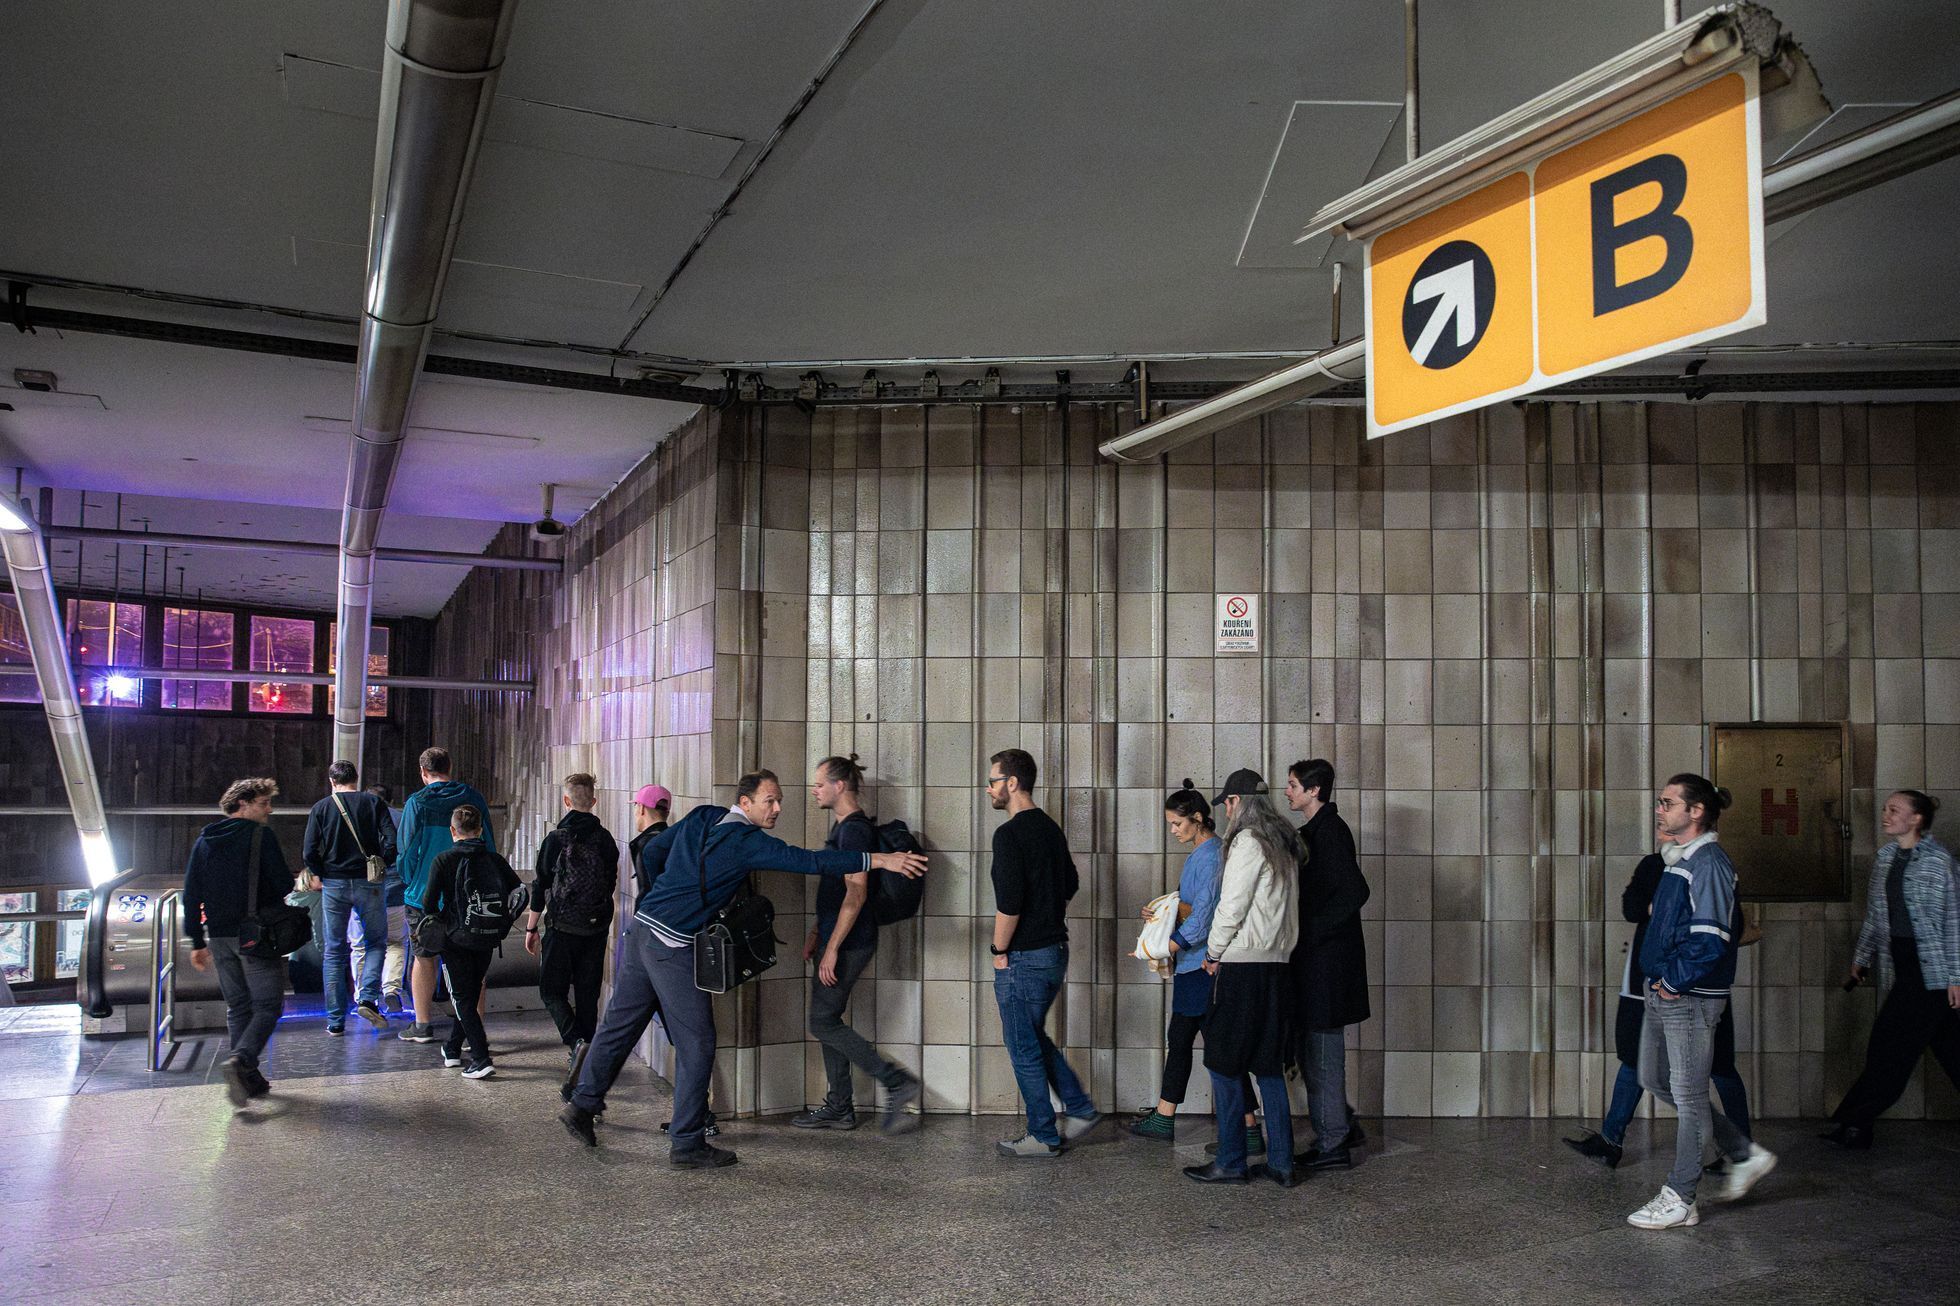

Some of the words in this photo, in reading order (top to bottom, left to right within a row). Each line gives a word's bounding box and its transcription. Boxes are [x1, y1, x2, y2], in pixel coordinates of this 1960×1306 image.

[1590, 153, 1694, 318] B
[1223, 618, 1252, 628] KOUŘENÍ
[1776, 754, 1784, 767] 2
[1761, 788, 1799, 836] H
